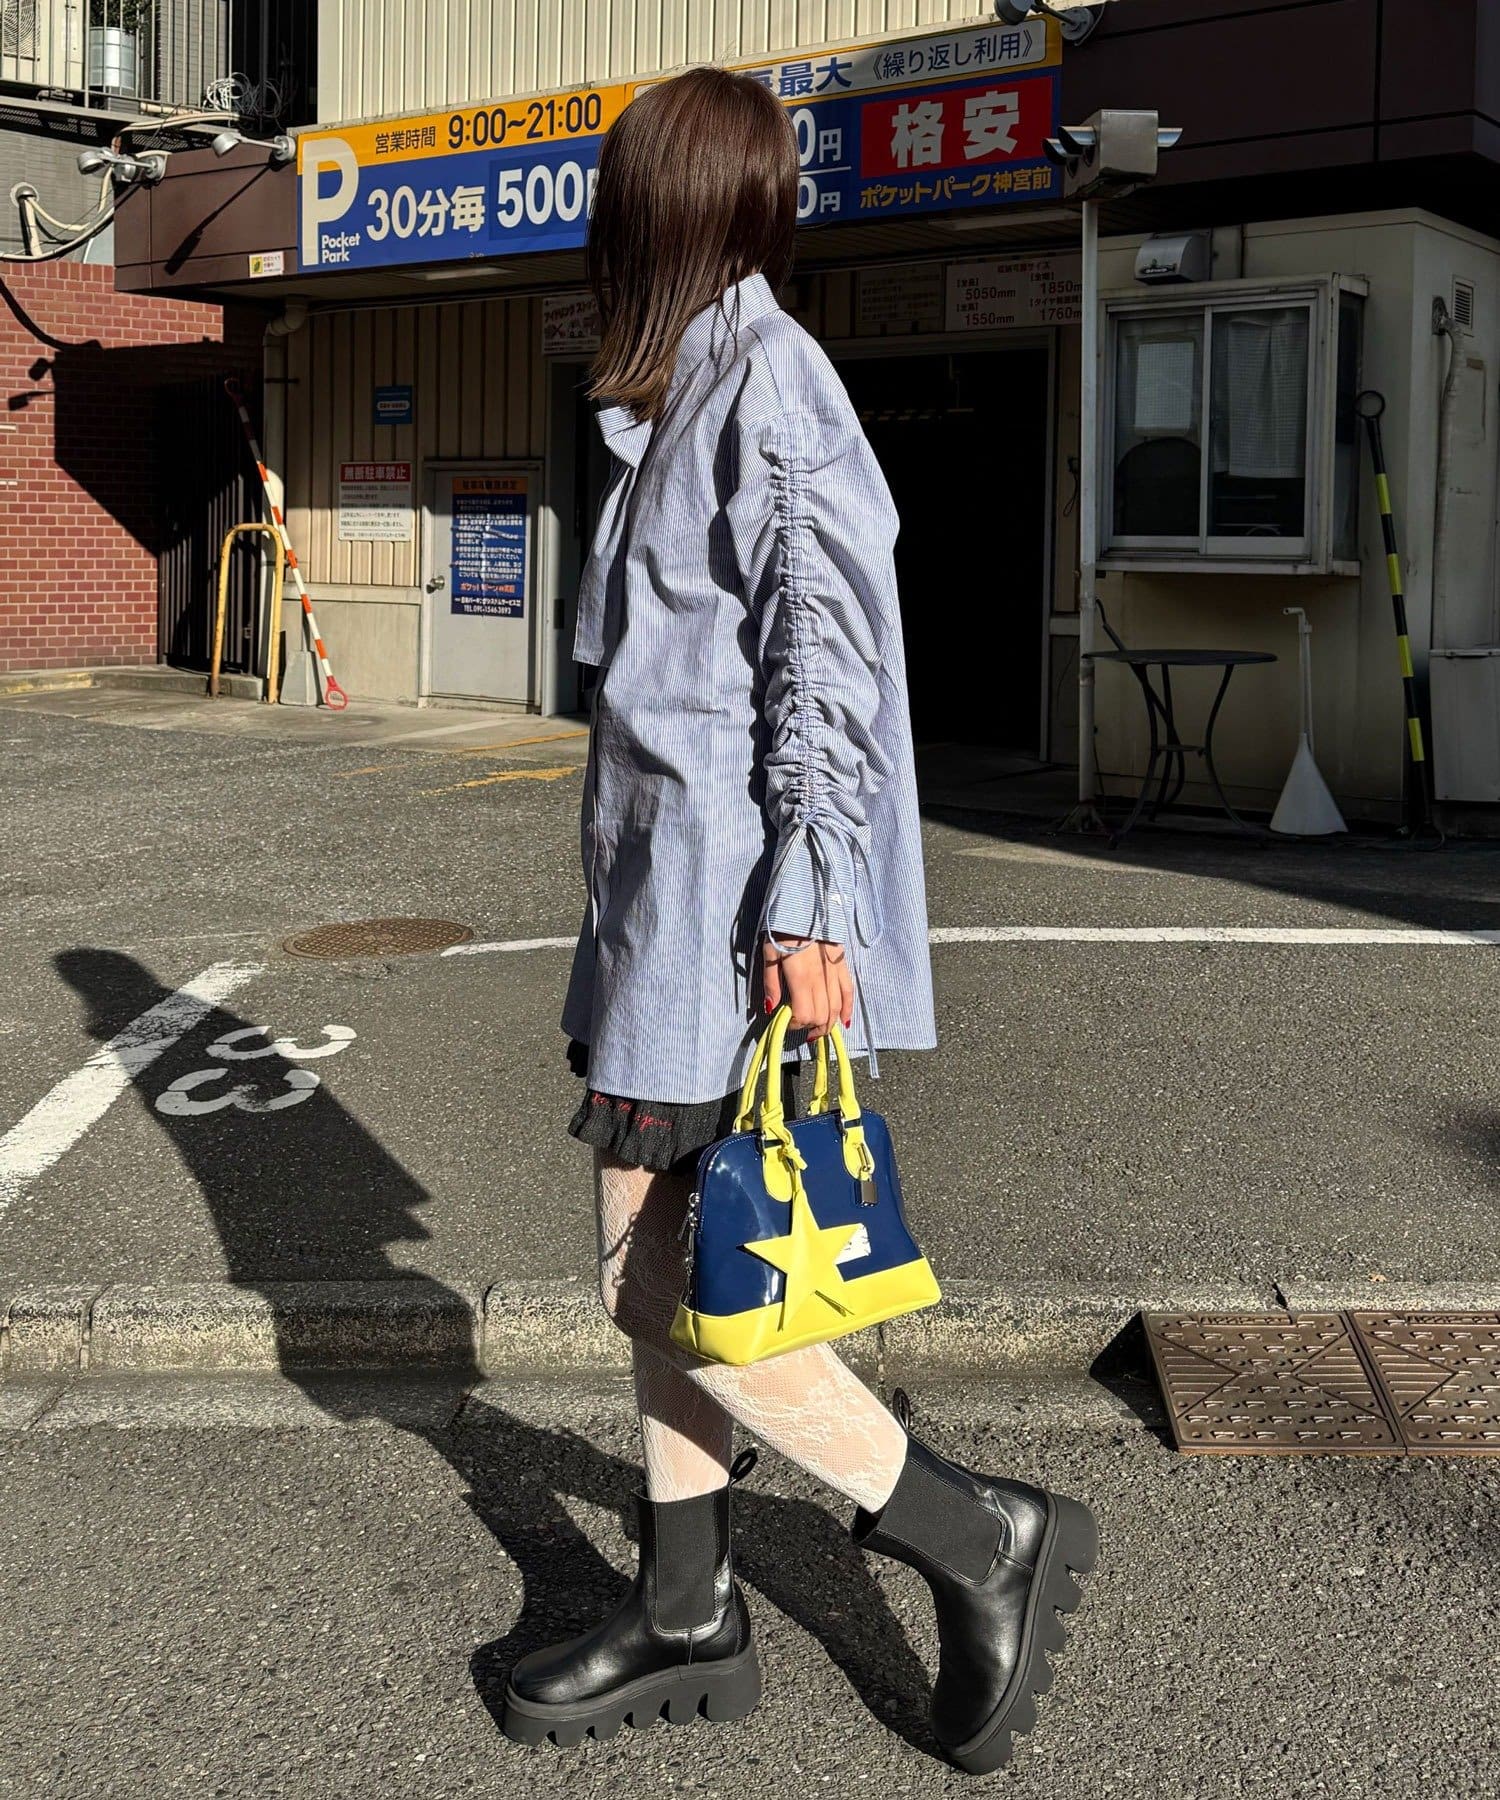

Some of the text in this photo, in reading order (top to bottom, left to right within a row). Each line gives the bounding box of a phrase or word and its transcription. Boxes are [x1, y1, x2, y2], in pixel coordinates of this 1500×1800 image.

[873, 29, 1033, 80] 《繰り返し利用》
[375, 126, 436, 154] 営業時間
[891, 91, 1020, 169] 格安
[302, 137, 360, 266] P
[860, 167, 1052, 209] ポケットパーク神宮前
[366, 185, 486, 241] 30分毎
[321, 231, 361, 249] Pocket
[321, 249, 351, 264] Park
[966, 286, 1016, 300] 5050mm
[965, 312, 1015, 327] 1550mm
